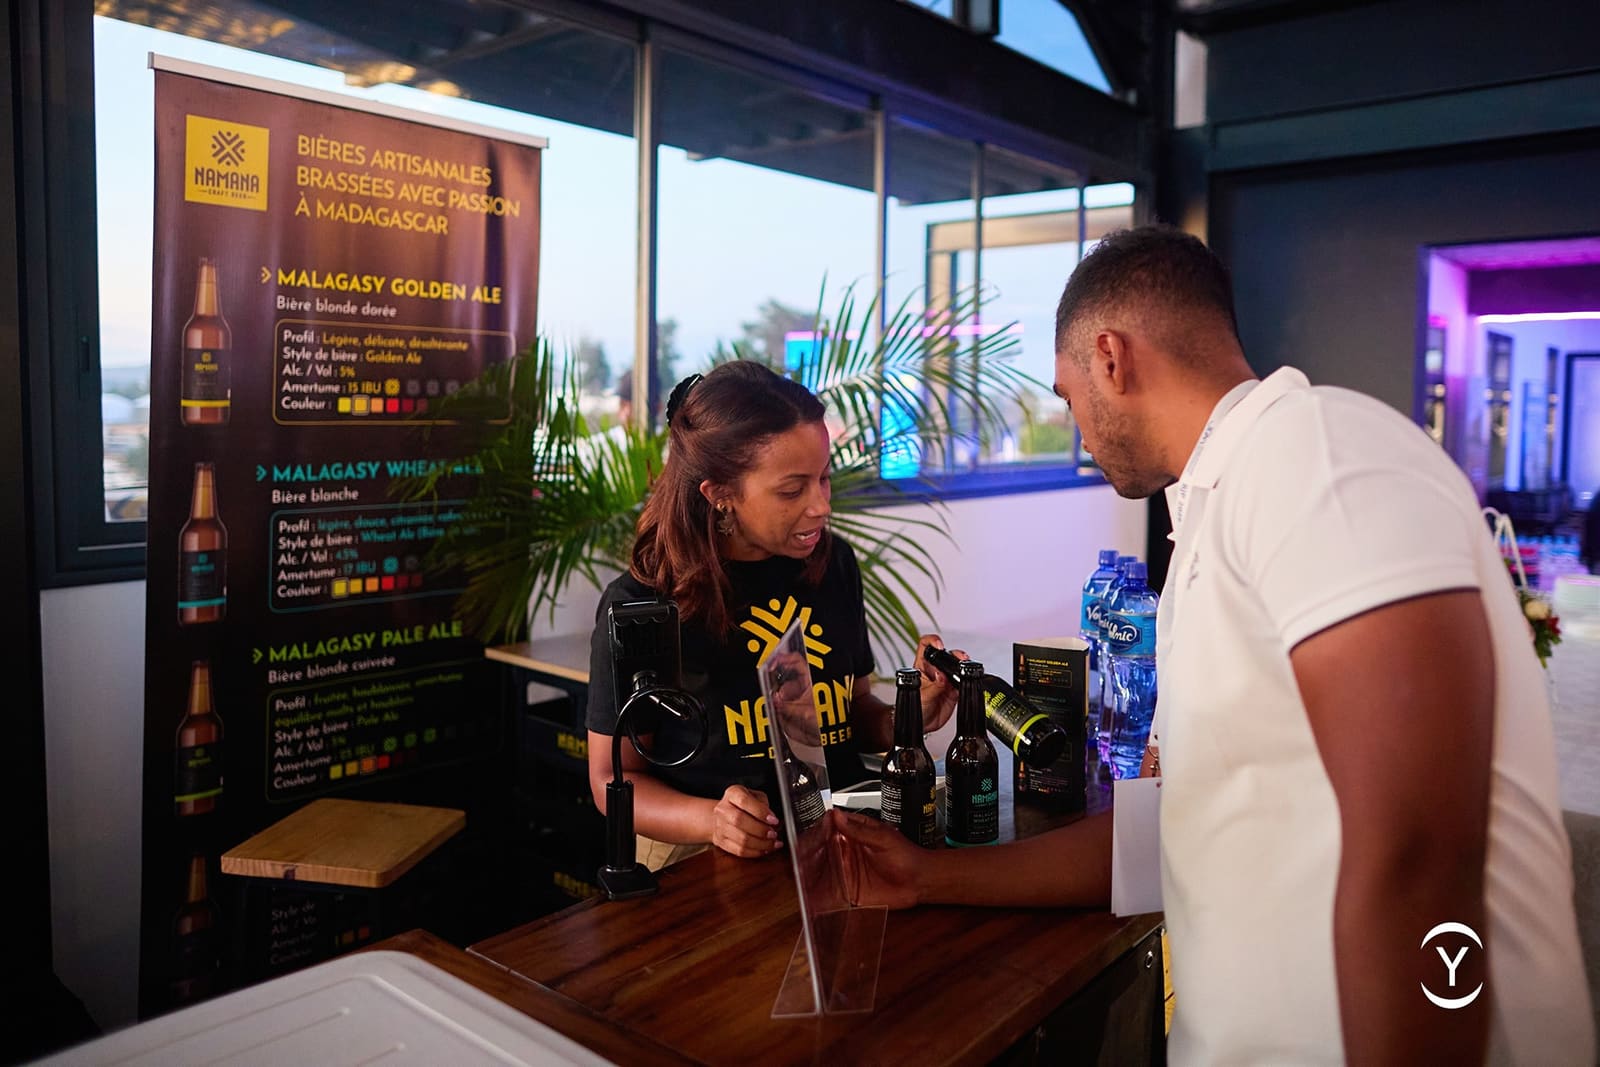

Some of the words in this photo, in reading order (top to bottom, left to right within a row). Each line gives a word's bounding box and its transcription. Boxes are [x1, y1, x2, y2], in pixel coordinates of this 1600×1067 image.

[298, 134, 366, 165] BIÈRES
[370, 149, 492, 187] ARTISANALES
[194, 167, 260, 193] NAMANA
[297, 166, 395, 199] BRASSÉES
[399, 185, 445, 207] AVEC
[449, 193, 521, 217] PASSION
[294, 191, 311, 217] À
[316, 203, 449, 235] MADAGASCAR
[277, 269, 385, 294] MALAGASY
[391, 278, 466, 301] GOLDEN
[471, 284, 501, 304] ALE
[276, 295, 312, 312] Bière
[316, 298, 358, 315] blonde
[361, 300, 397, 317] dorée
[283, 329, 315, 344] Profil
[282, 348, 312, 363] Style
[314, 347, 329, 361] de
[333, 348, 358, 362] bière
[365, 350, 403, 363] Golden
[406, 351, 423, 364] Ale
[315, 363, 333, 377] Vol
[282, 380, 341, 394] Amertume
[281, 395, 326, 410] Couleur
[272, 460, 381, 482] MALAGASY
[272, 488, 307, 504] Bière
[310, 485, 359, 502] blanche
[279, 518, 310, 533] Profil
[278, 535, 308, 551] Style
[310, 533, 324, 548] de
[326, 532, 353, 546] bière
[310, 549, 328, 563] Vol
[277, 567, 336, 581] Amertume
[276, 583, 322, 598] Couleur
[268, 631, 376, 663] MALAGASY
[380, 624, 425, 648] PALE
[428, 620, 464, 640] ALE
[267, 668, 303, 684] Bière
[306, 660, 349, 679] blonde
[274, 695, 306, 712] Profil
